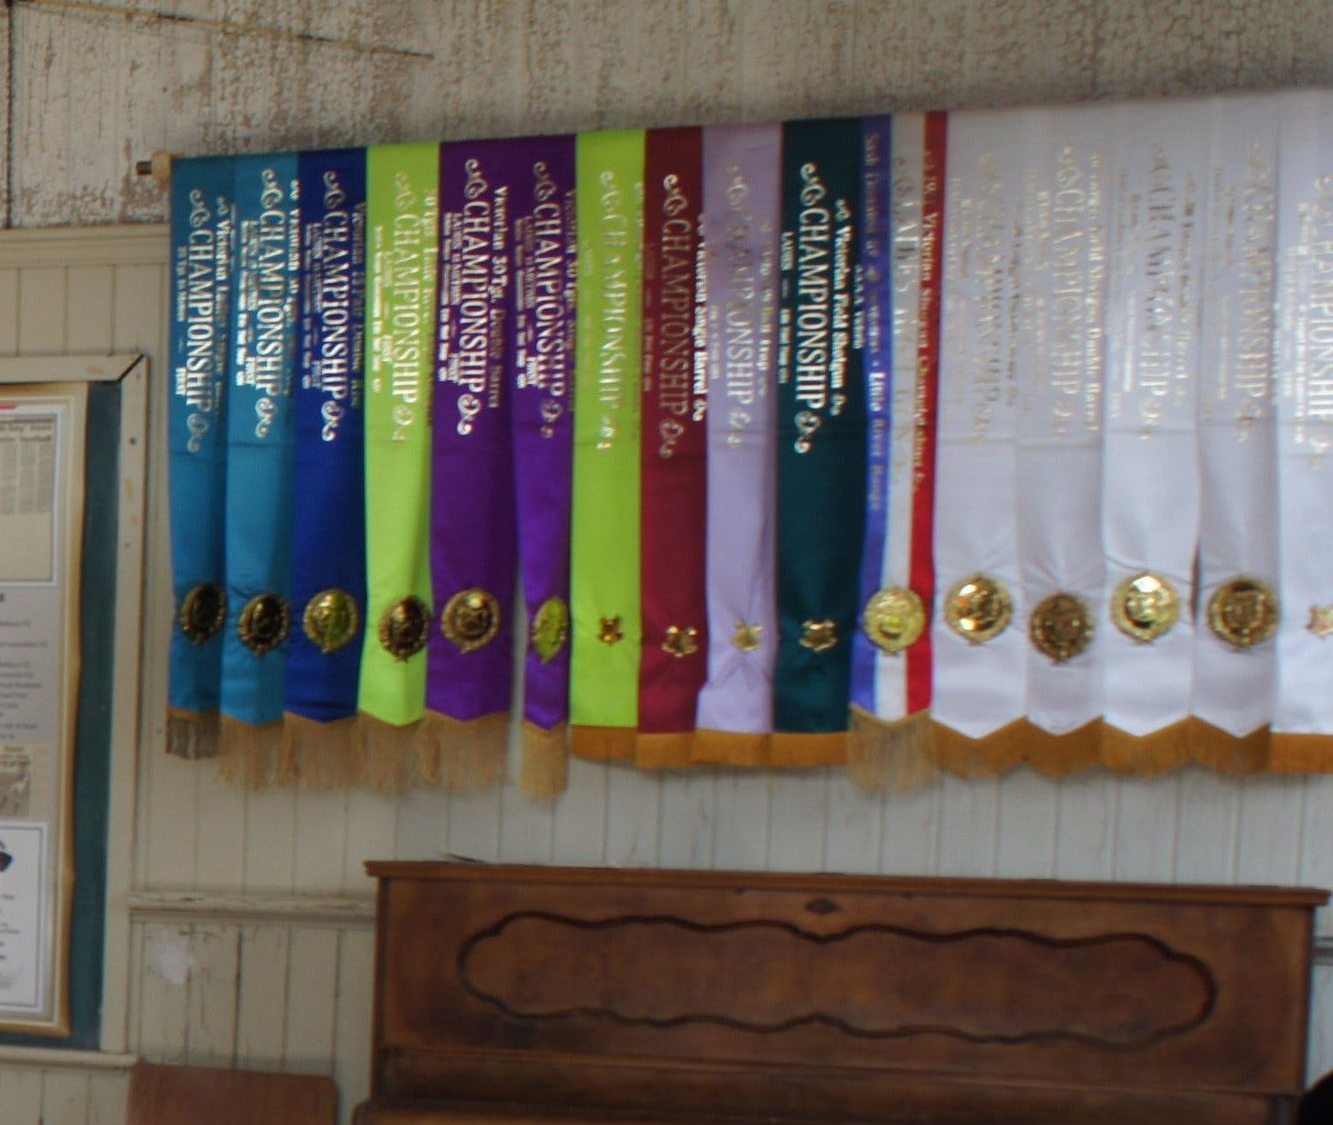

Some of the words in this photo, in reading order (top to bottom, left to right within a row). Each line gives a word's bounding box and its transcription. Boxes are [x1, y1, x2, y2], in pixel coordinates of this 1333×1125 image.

[255, 210, 285, 397] CHAMPIONSHIP
[321, 211, 349, 400] CHAMPIONSHIP
[391, 214, 419, 402] CHAMPIONSHIP
[458, 201, 488, 392] CHAMPIONSHIP
[493, 186, 508, 250] Victorian
[534, 203, 565, 396] CHAMPIONSHIP
[598, 214, 628, 409] CHAMPIONSHIP
[795, 208, 830, 408] CHAMPIONSHIP
[832, 226, 852, 289] Victorian
[832, 293, 852, 328] Field
[1050, 187, 1085, 394] CHAMPIONSHIP
[186, 230, 213, 412] CHAMPIONSHIP
[659, 219, 690, 416] CHAMPIONSHIP
[829, 332, 848, 388] Shotgun
